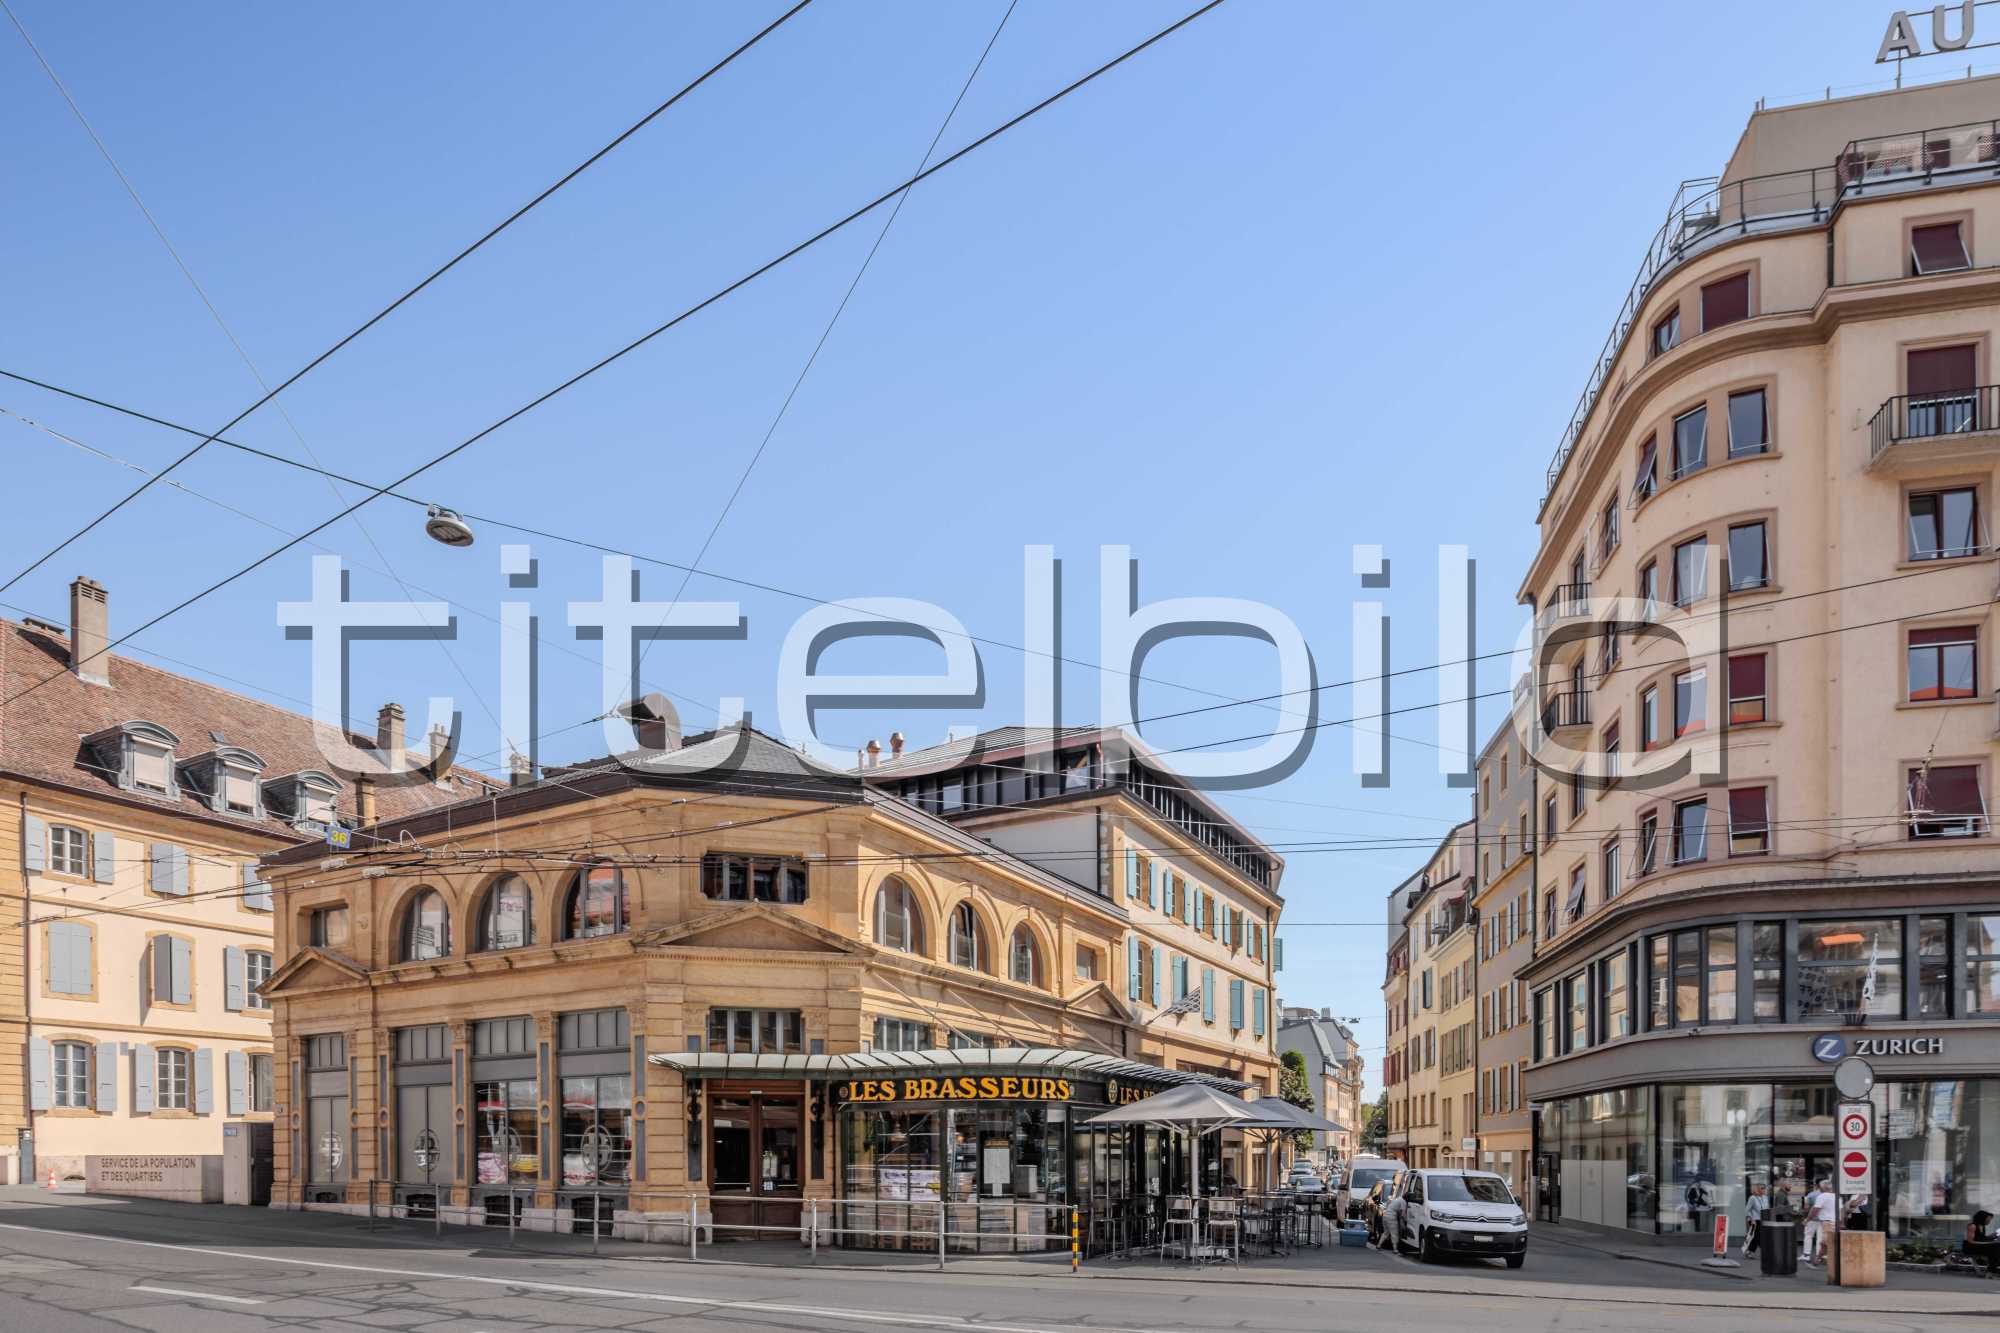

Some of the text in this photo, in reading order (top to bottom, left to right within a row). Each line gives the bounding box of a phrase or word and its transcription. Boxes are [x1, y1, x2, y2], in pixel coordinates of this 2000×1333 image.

[1875, 0, 1975, 64] AU
[331, 831, 347, 844] 36
[1856, 1037, 1944, 1055] ZURICH
[849, 1076, 1070, 1102] LES BRASSEURS
[1849, 1121, 1861, 1132] 30
[101, 1158, 196, 1169] SERVICE DE LA POPULATION
[101, 1171, 163, 1184] ET DES QUARTIERS
